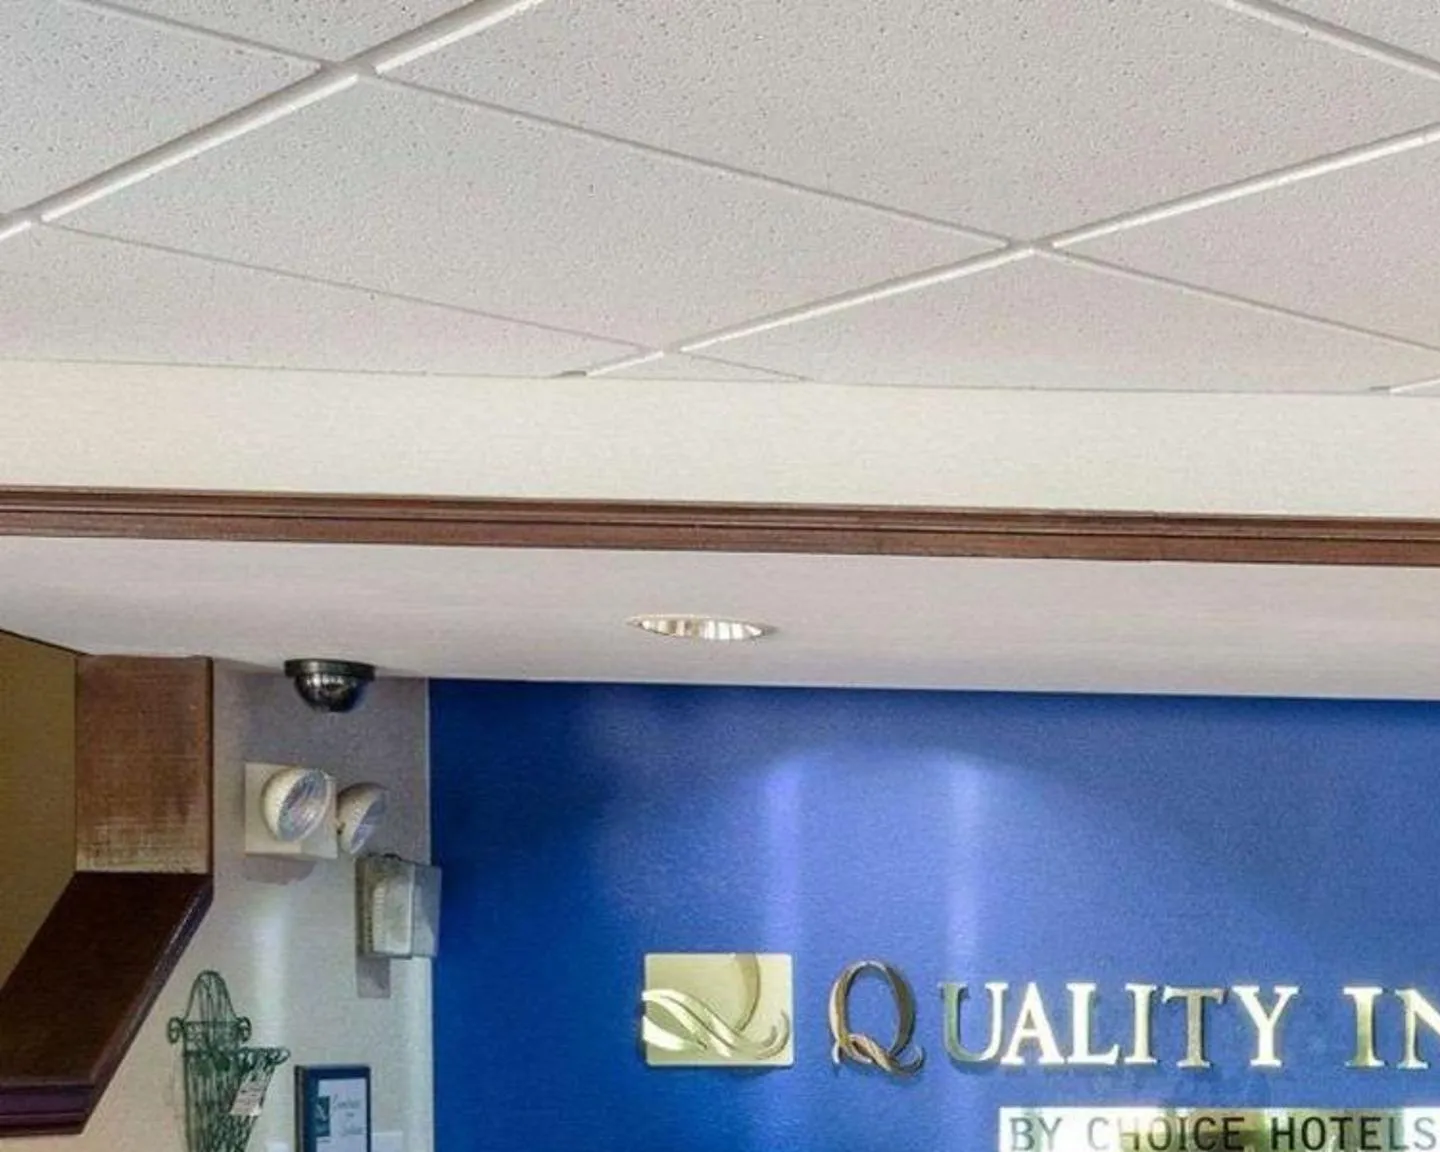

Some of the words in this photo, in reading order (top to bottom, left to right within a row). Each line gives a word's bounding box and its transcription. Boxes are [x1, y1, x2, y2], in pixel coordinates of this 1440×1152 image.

[827, 958, 1299, 1075] QUALITY
[1009, 1116, 1063, 1151] BY
[1086, 1115, 1246, 1152] CHOICE
[1270, 1115, 1437, 1151] HOTELS
